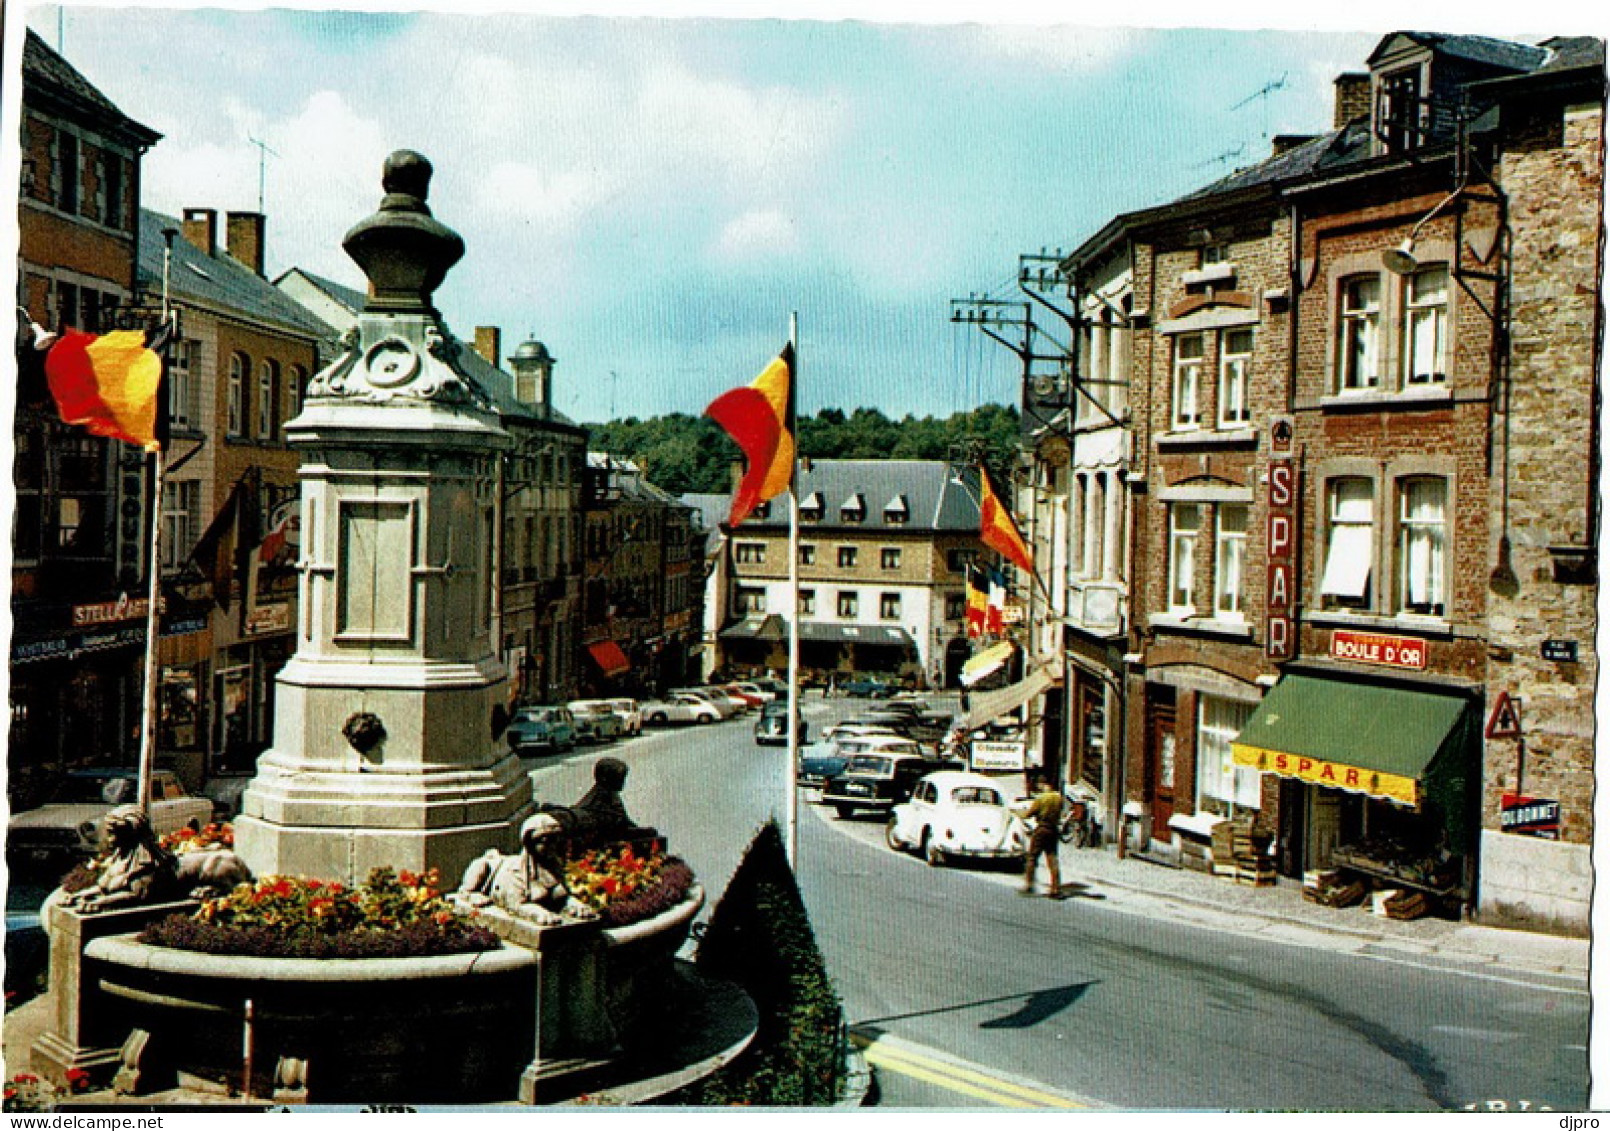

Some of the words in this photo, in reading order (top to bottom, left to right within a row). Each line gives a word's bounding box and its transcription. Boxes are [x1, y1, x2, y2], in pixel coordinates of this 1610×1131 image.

[1270, 468, 1290, 655] SPAR
[1335, 641, 1380, 660] BOULE
[1385, 646, 1421, 665] D'OR
[1275, 754, 1360, 786] SPAR
